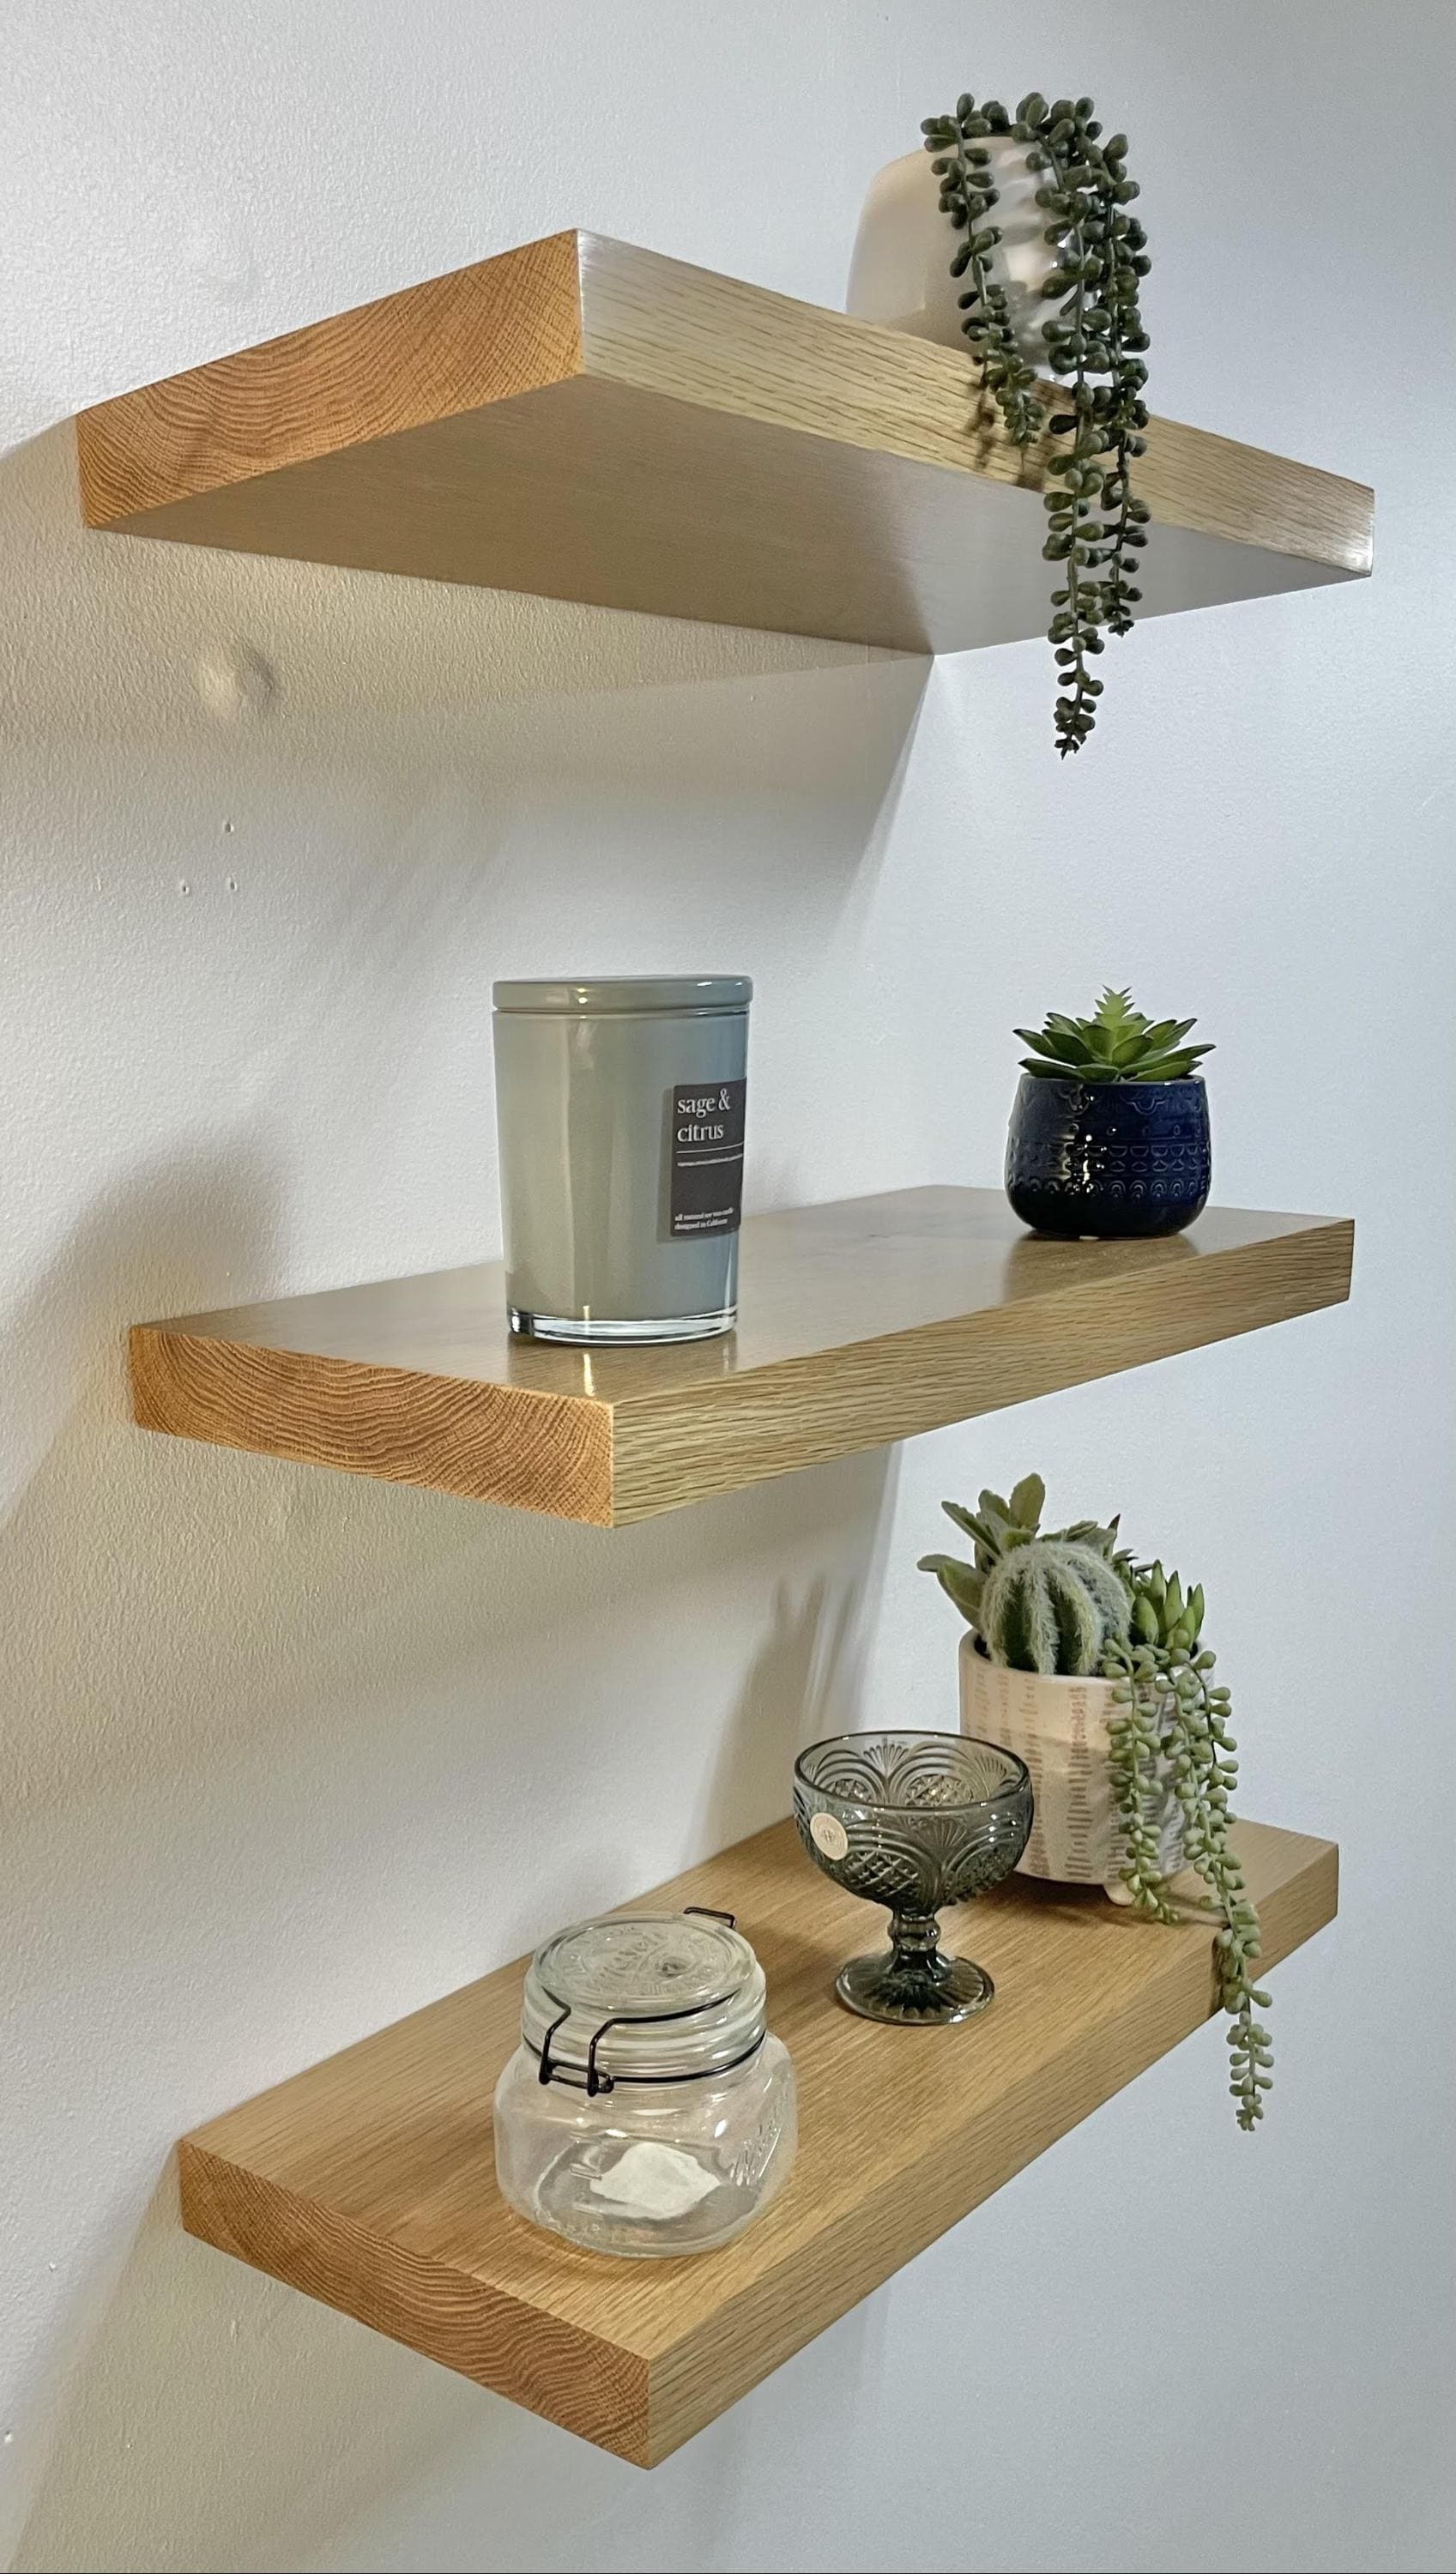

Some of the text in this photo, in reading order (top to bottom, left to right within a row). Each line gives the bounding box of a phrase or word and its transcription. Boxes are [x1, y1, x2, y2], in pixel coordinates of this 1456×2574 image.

[677, 1088, 731, 1119] sage &
[677, 1124, 724, 1143] citrus
[706, 1218, 728, 1227] Calif
